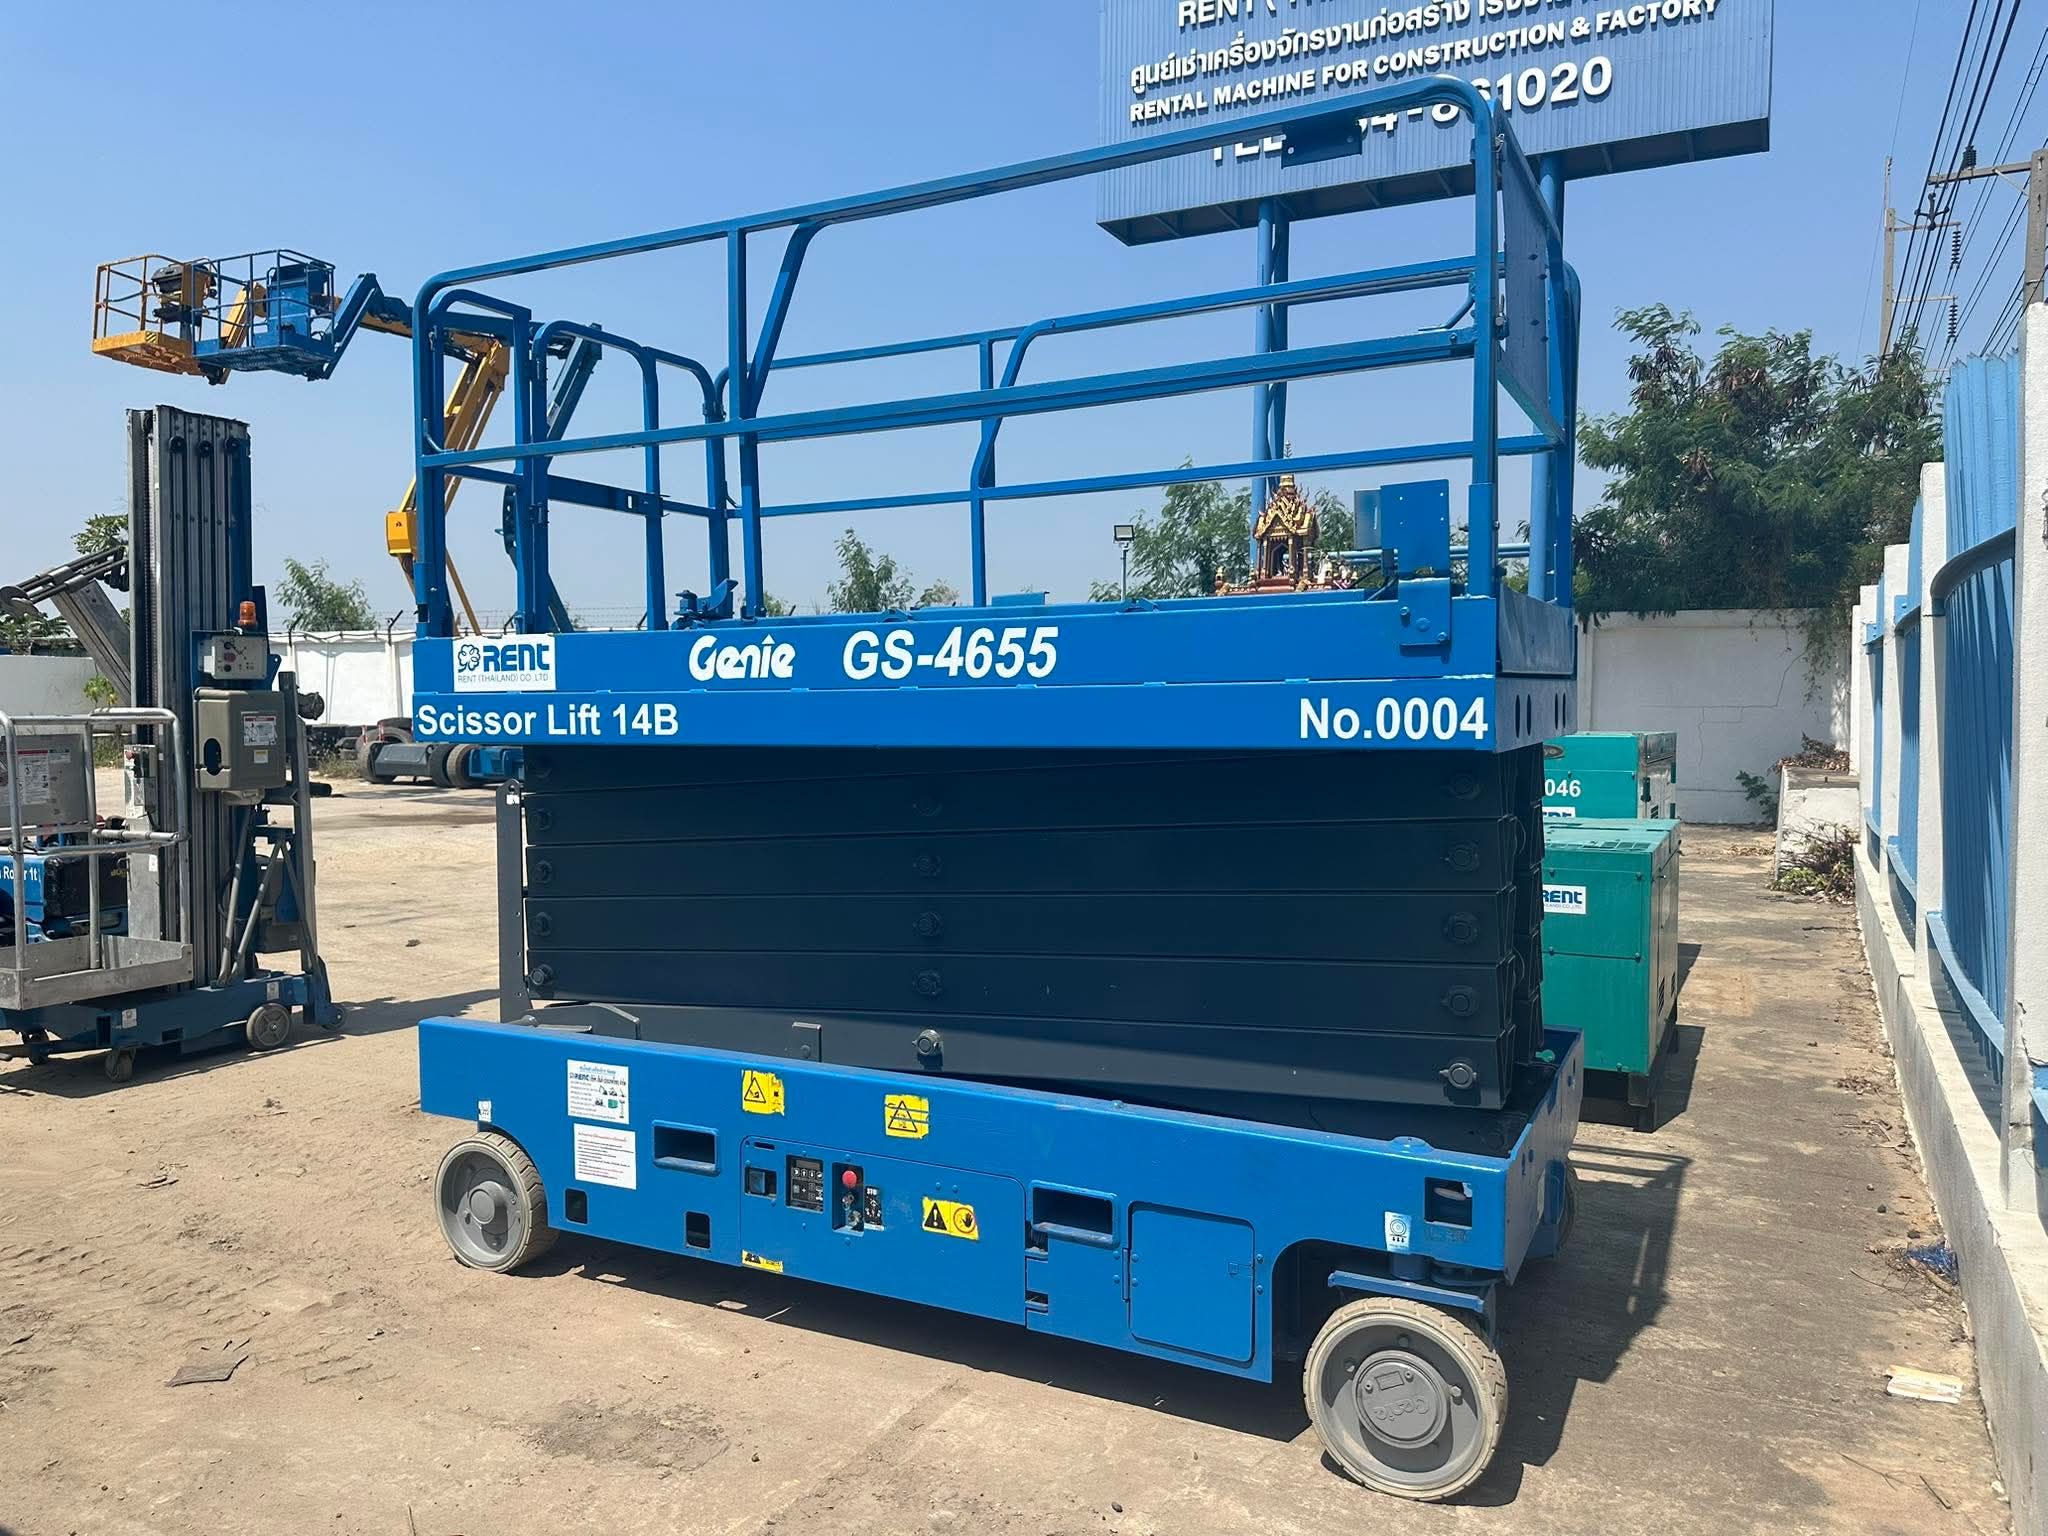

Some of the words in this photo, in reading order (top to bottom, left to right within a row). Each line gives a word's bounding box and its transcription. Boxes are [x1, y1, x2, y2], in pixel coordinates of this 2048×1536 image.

[1130, 92, 1208, 121] RENTAL
[1213, 70, 1316, 106] MACHINE
[1322, 60, 1368, 85] FOR
[1373, 21, 1565, 74] CONSTRUCTION
[1569, 17, 1591, 38] &
[1596, 0, 1719, 33] FACTORY
[688, 633, 796, 681] Genie
[843, 626, 1059, 680] GS-4655
[457, 674, 476, 683] RENT
[418, 704, 537, 736] Scissor
[547, 703, 602, 736] Lift
[612, 703, 679, 736] 14B
[1299, 697, 1489, 741] No.0004
[1544, 778, 1582, 798] 046
